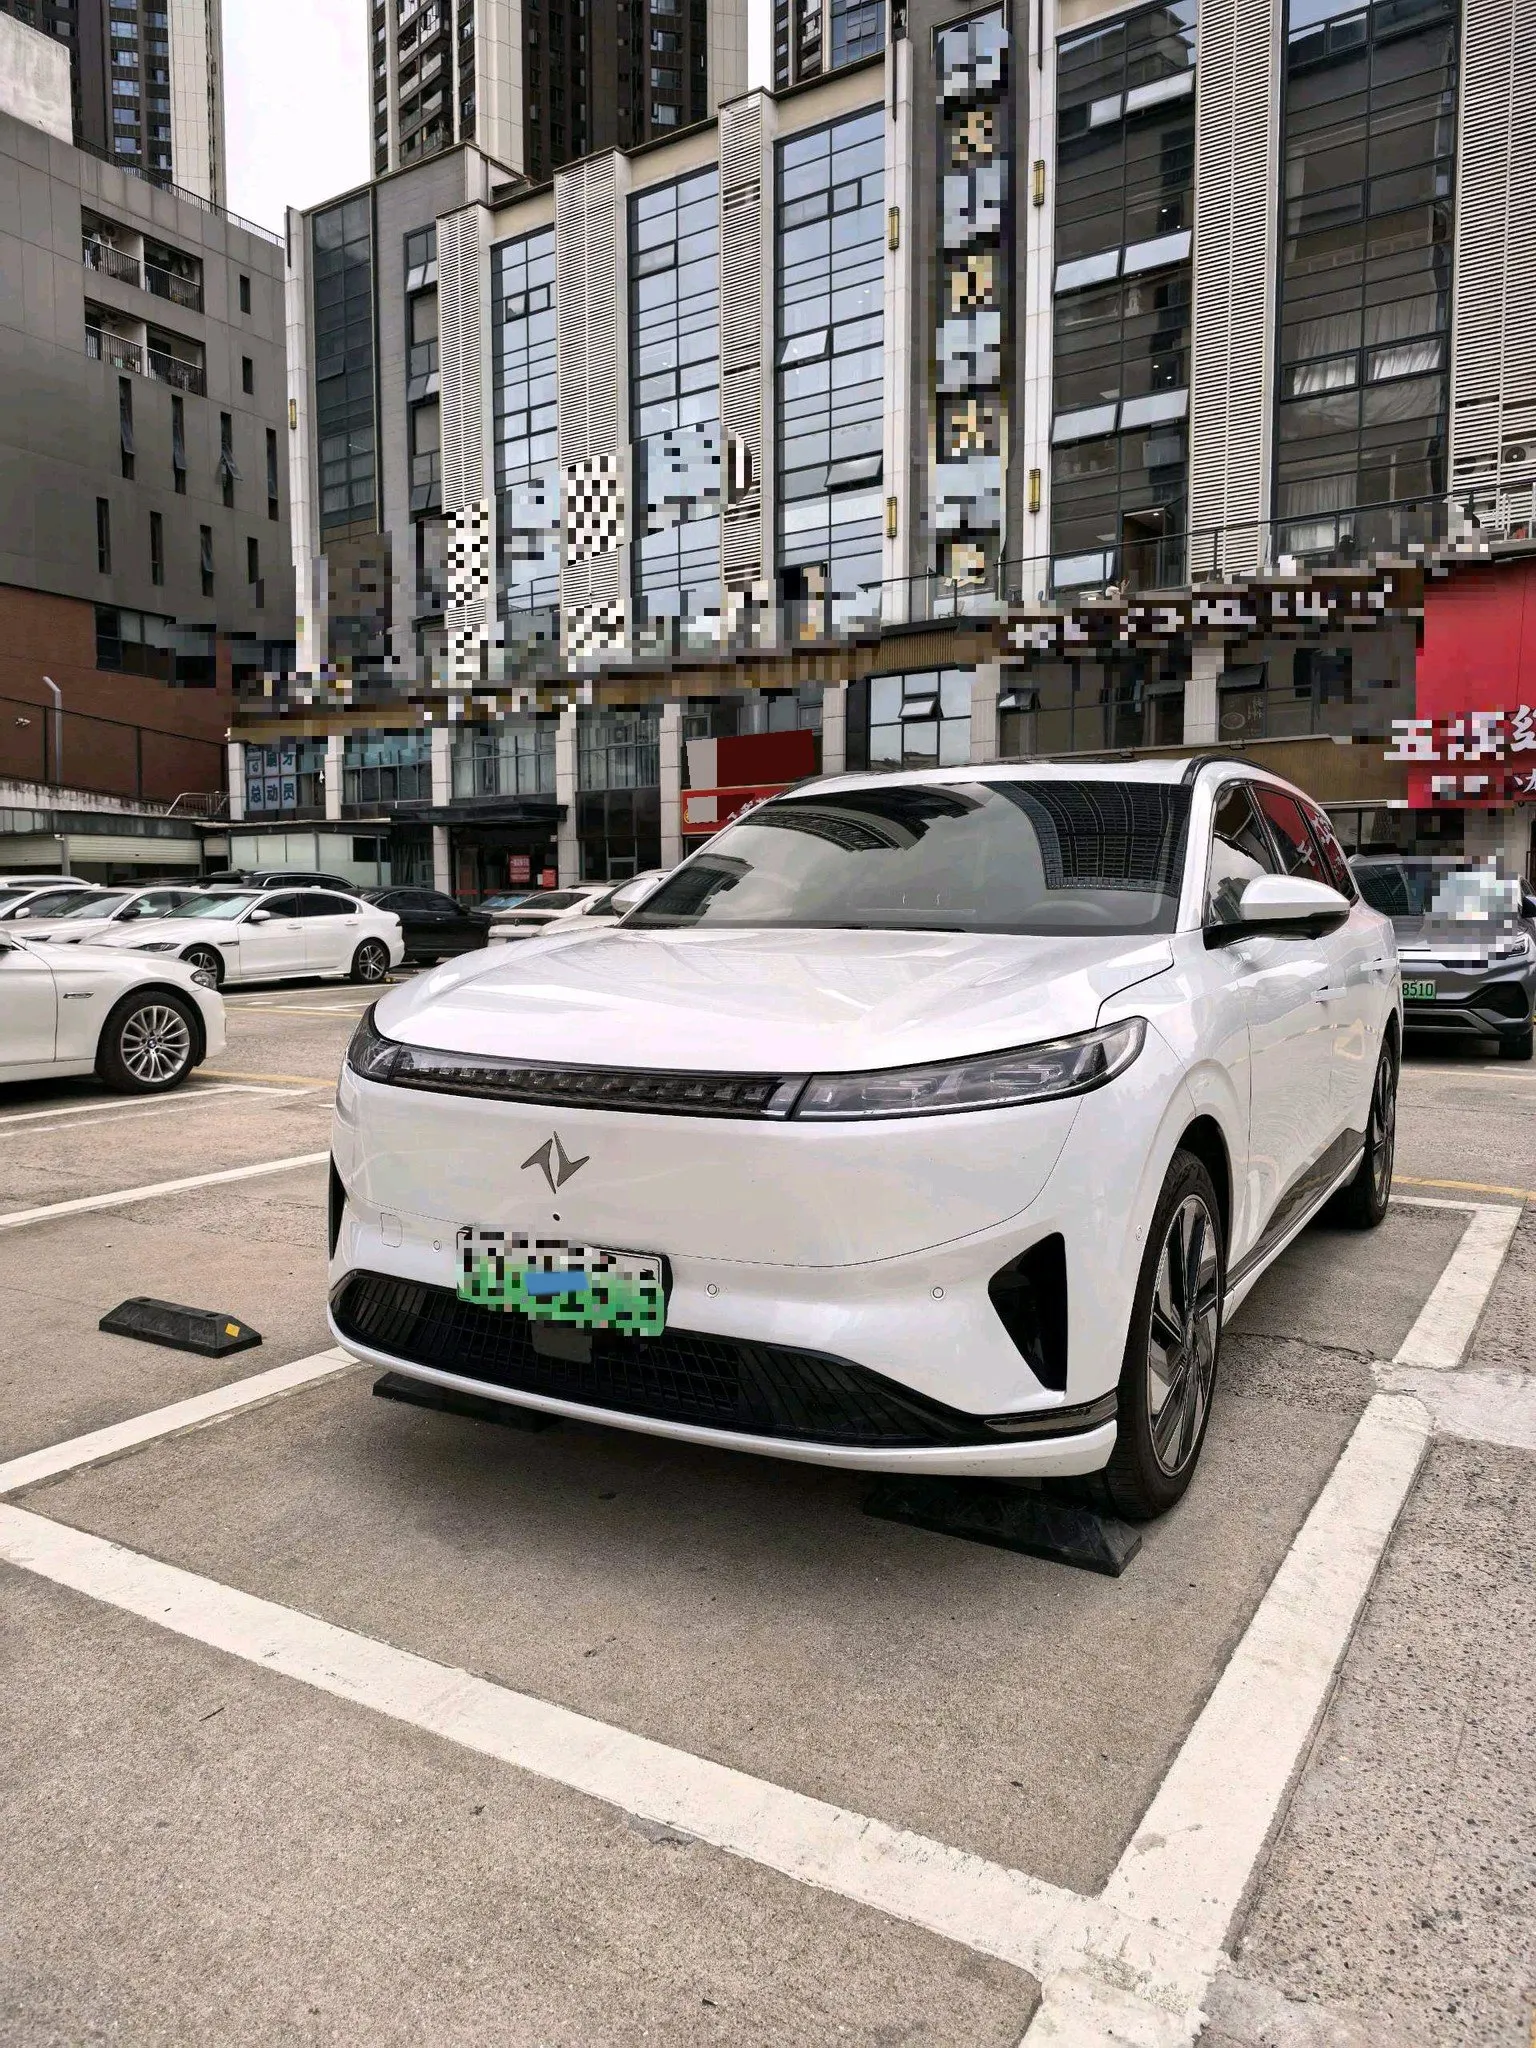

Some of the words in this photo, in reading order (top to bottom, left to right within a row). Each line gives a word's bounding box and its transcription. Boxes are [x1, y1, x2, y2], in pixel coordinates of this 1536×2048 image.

[250, 783, 295, 803] 总动员
[1402, 982, 1434, 997] 8510
